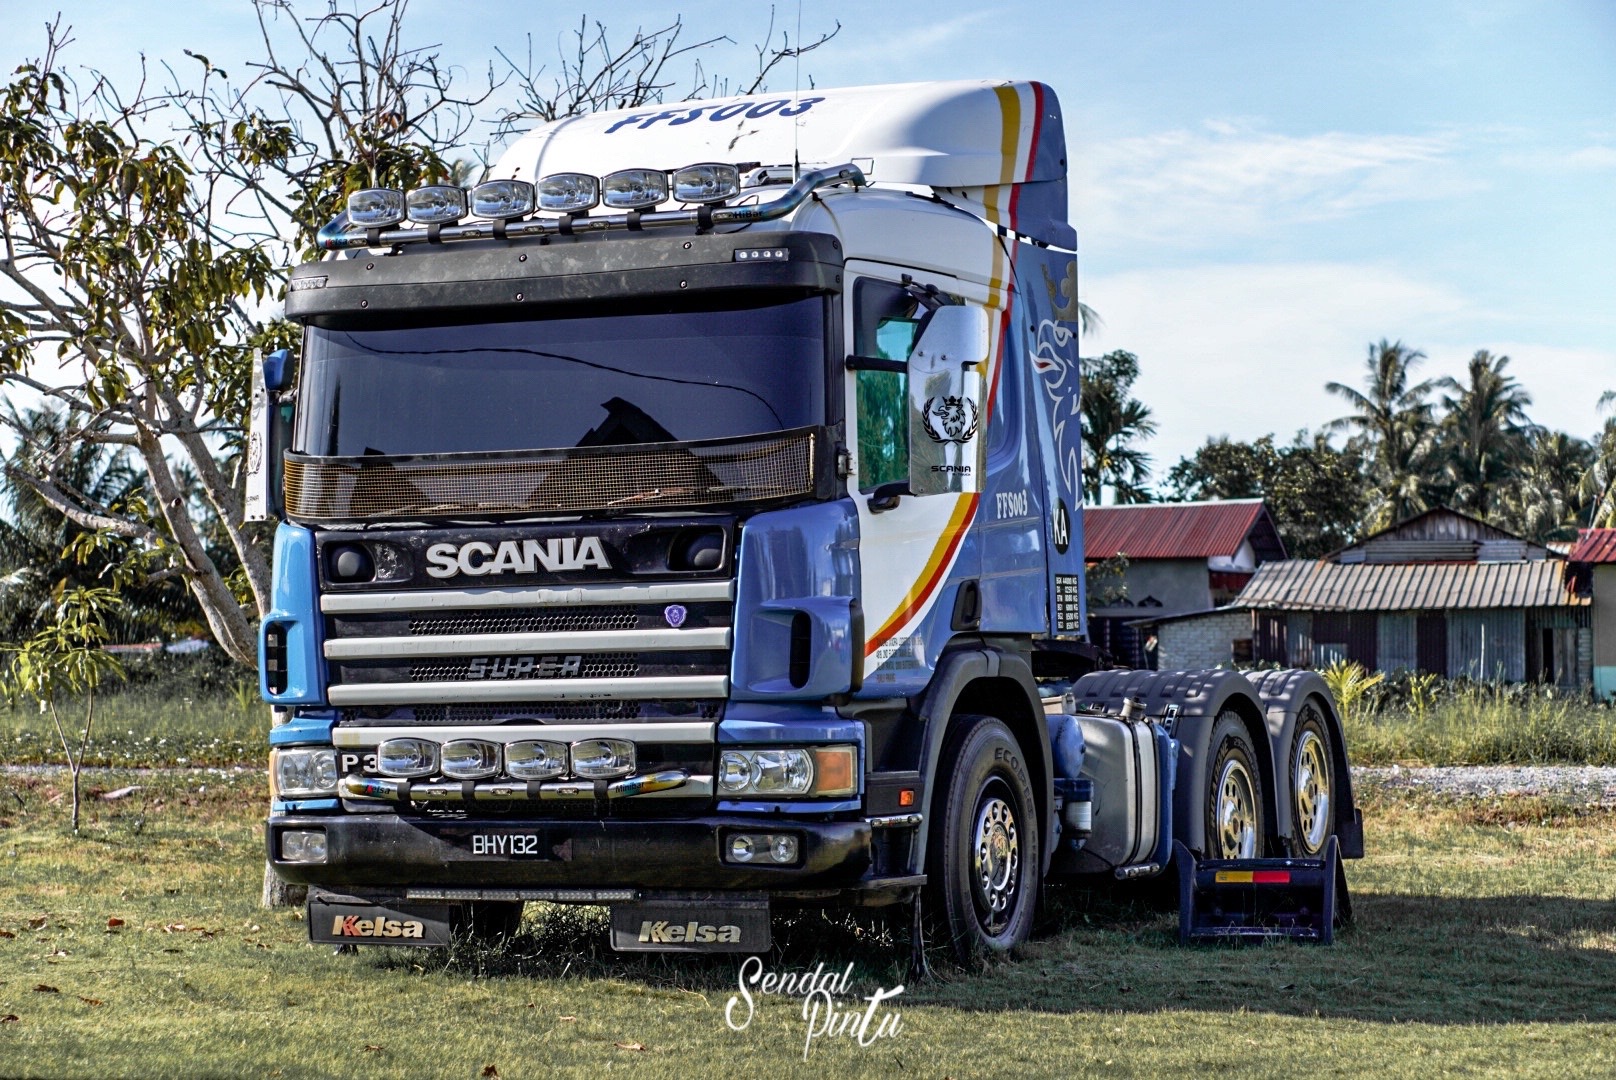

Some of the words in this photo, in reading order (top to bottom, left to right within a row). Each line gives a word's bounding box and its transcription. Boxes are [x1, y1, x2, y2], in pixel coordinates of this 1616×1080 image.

[604, 96, 826, 135] FFS003
[931, 465, 971, 473] SCANIA
[996, 488, 1028, 519] FFS003
[1052, 508, 1069, 545] KA
[426, 536, 612, 579] SCANIA
[467, 655, 582, 679] SUPER
[341, 754, 359, 773] P
[615, 781, 644, 793] Minibar
[473, 834, 538, 855] BHY132
[332, 915, 425, 939] Kelsa
[638, 920, 742, 943] Kelsa
